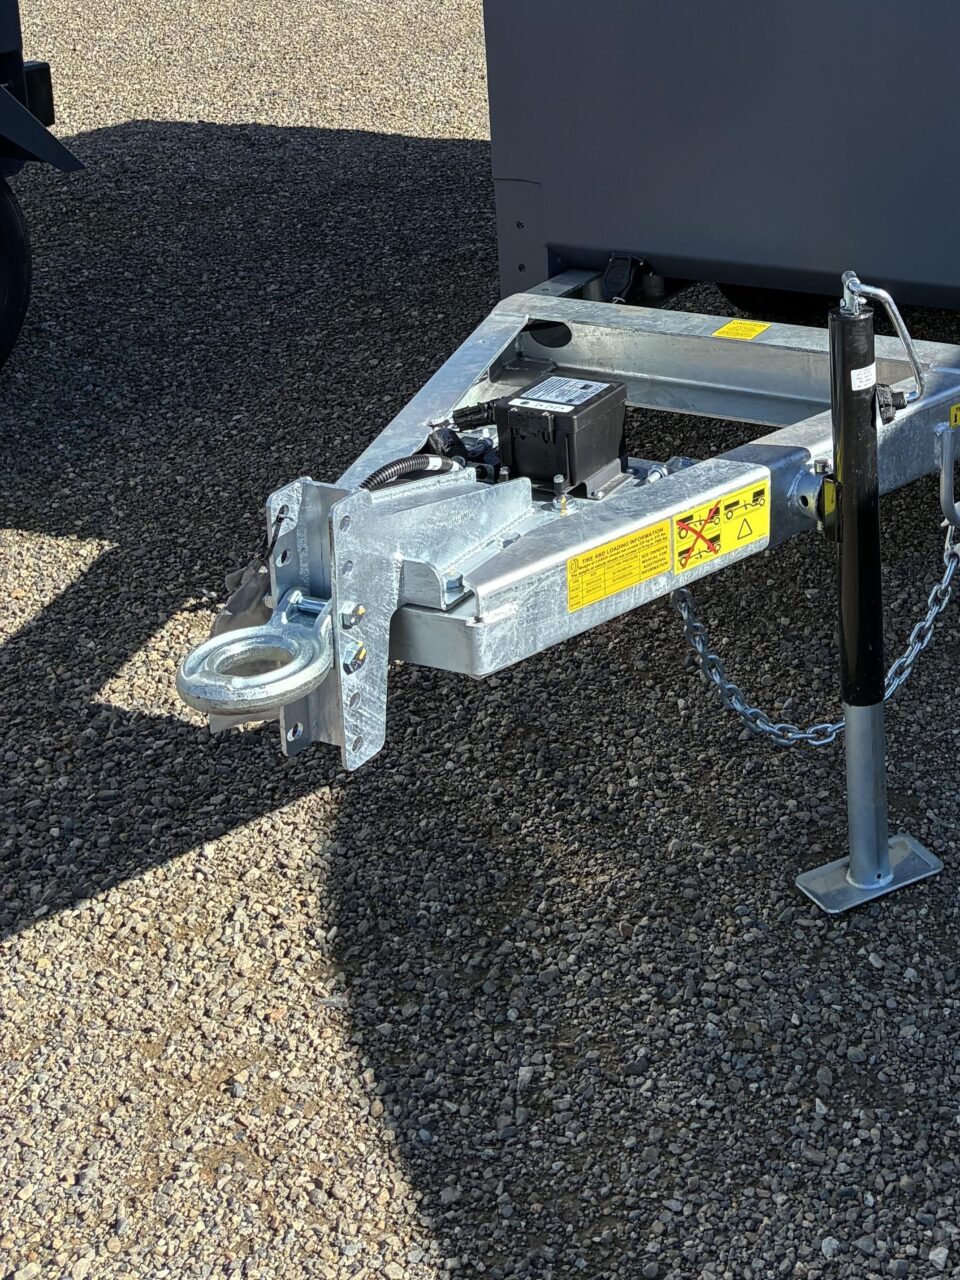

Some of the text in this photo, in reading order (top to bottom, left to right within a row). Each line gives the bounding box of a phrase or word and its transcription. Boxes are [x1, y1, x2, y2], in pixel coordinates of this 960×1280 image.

[595, 550, 606, 559] AND
[606, 541, 629, 555] LOADING
[630, 528, 664, 544] INFORMATION
